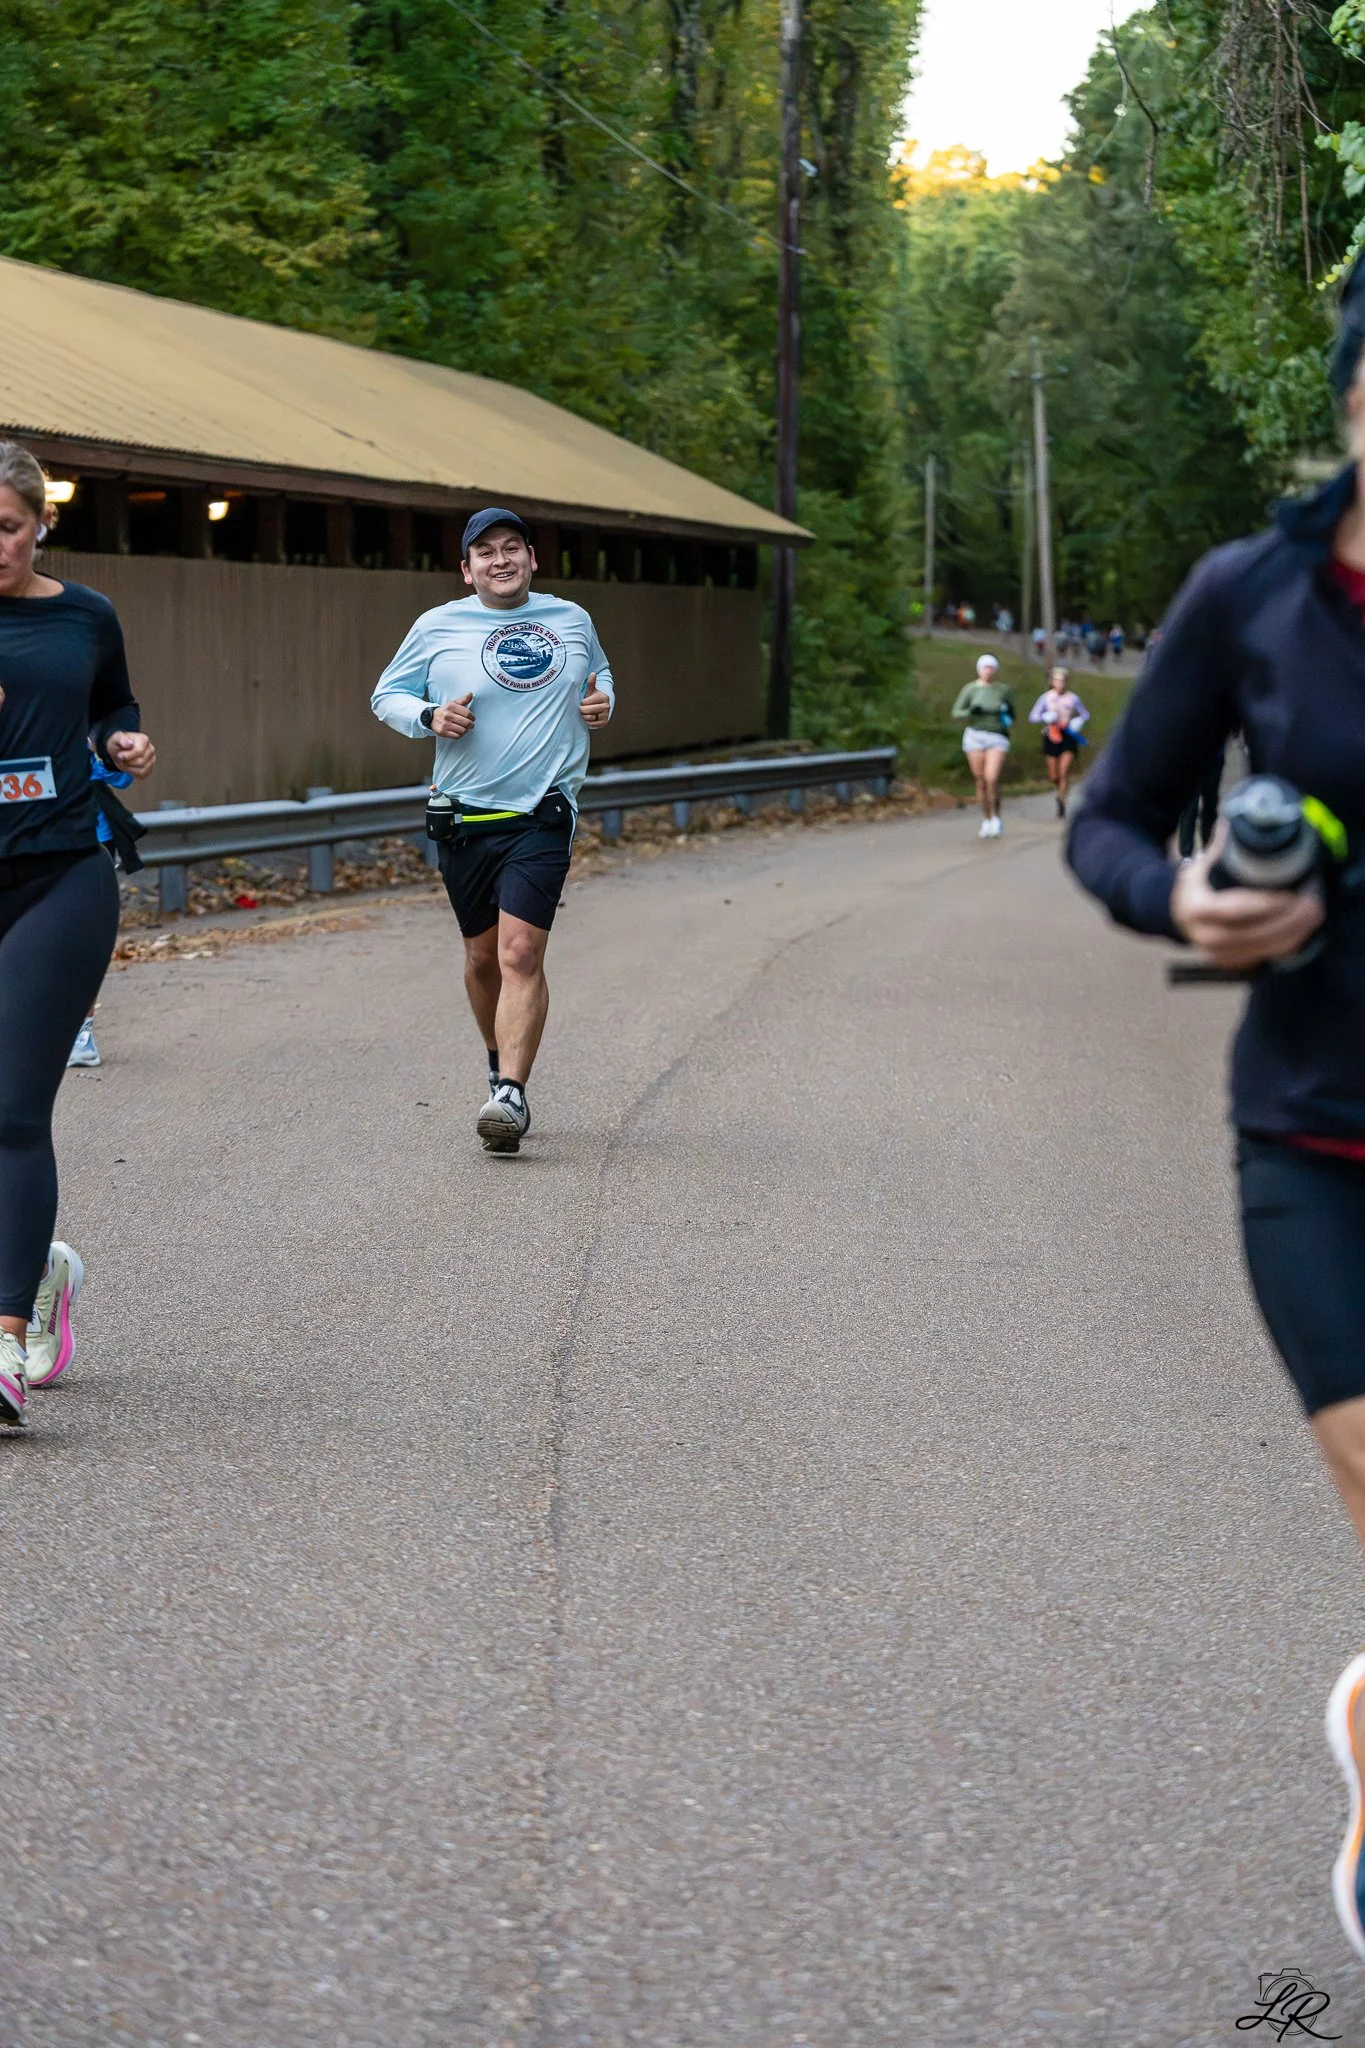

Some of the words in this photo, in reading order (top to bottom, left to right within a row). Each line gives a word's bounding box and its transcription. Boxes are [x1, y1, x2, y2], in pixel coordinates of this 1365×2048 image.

[486, 635, 500, 651] ROAD
[499, 626, 519, 637] RACE
[519, 624, 544, 634] SERIES
[544, 631, 561, 646] 2026
[496, 673, 509, 685] LANE
[531, 669, 557, 688] MEMORIAL
[0, 773, 43, 800] 36
